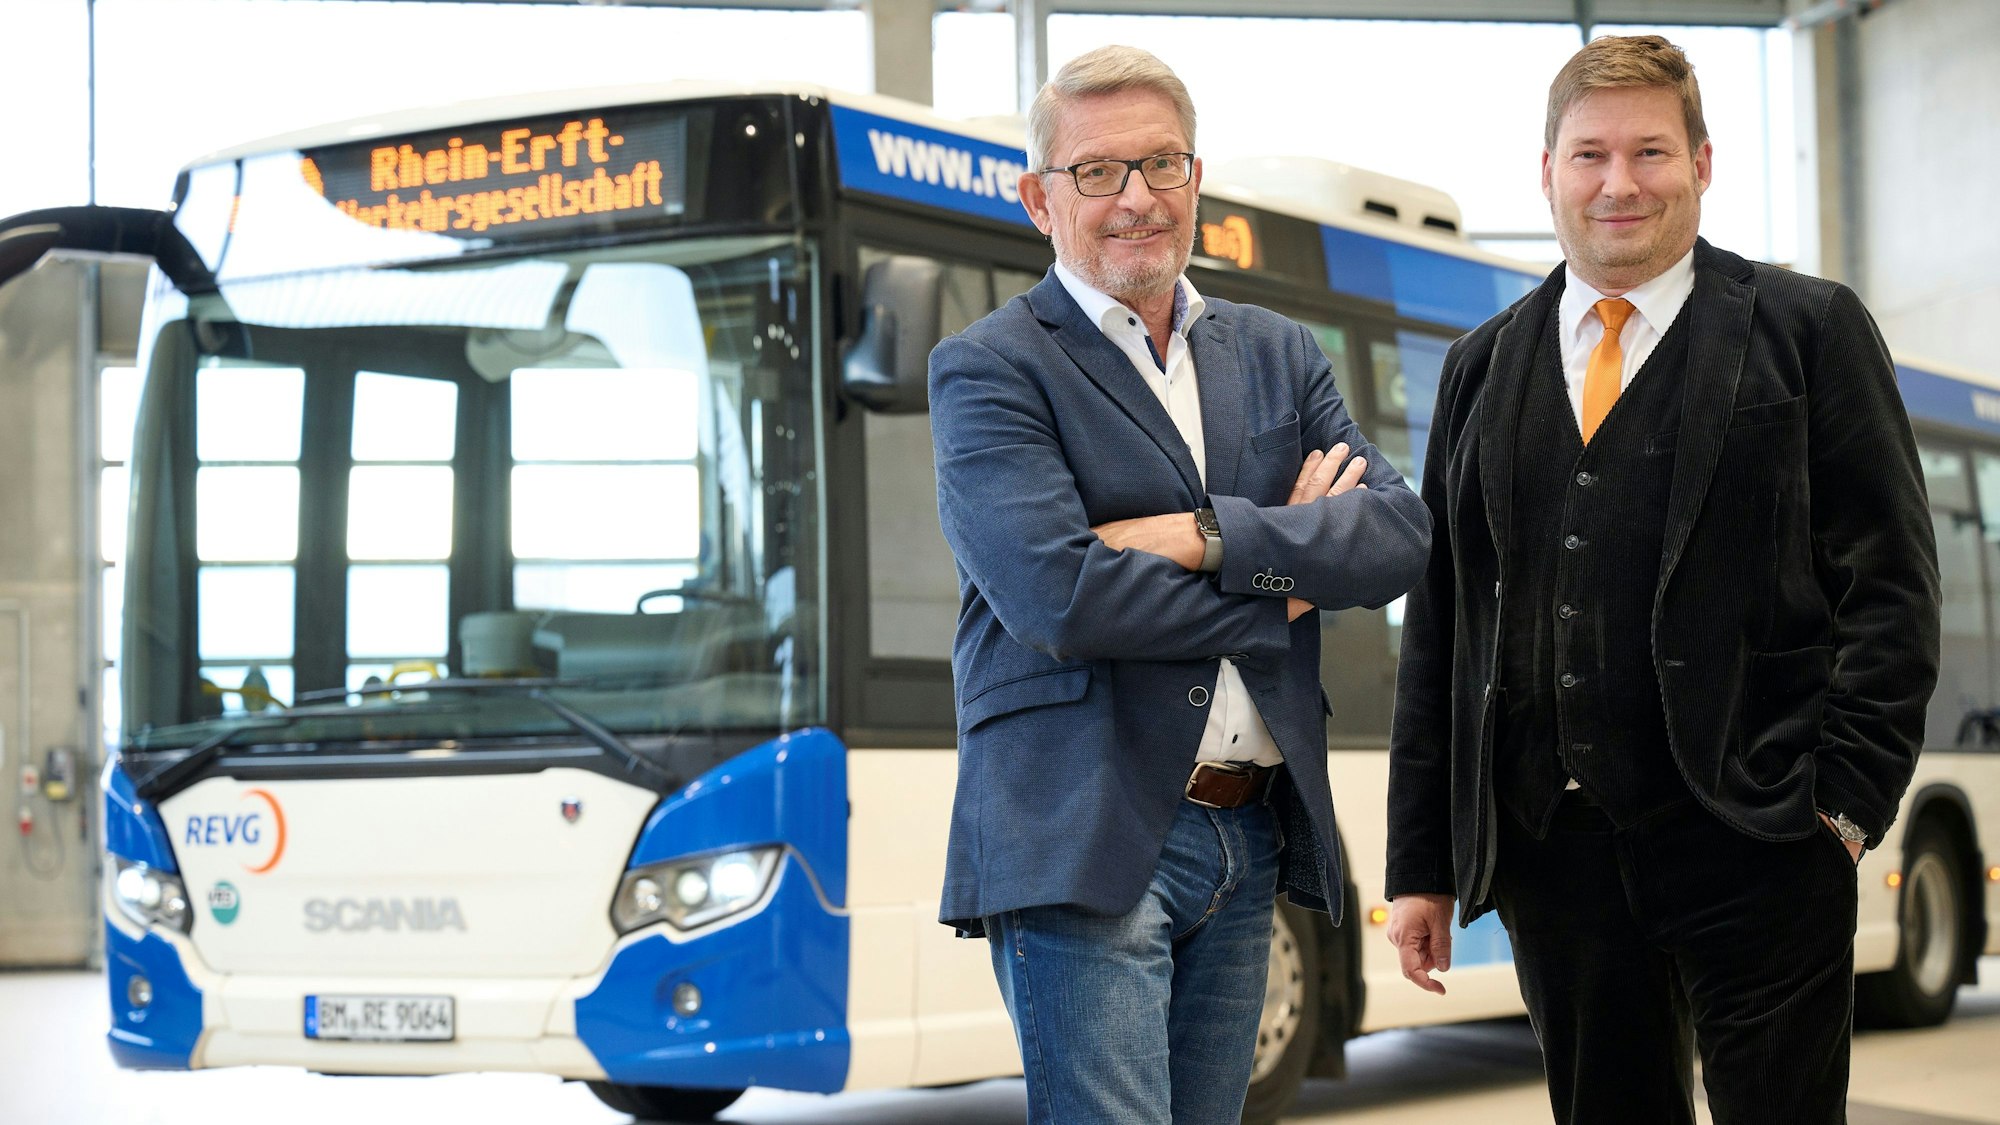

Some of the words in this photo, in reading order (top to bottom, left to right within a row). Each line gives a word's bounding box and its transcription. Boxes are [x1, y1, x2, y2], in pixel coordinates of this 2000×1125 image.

[371, 118, 624, 192] Rhein-Erft-
[185, 813, 261, 846] REVG
[303, 898, 468, 933] SCANIA
[321, 1001, 348, 1029] BM
[363, 1001, 389, 1030] RE
[396, 1002, 449, 1030] 9064
